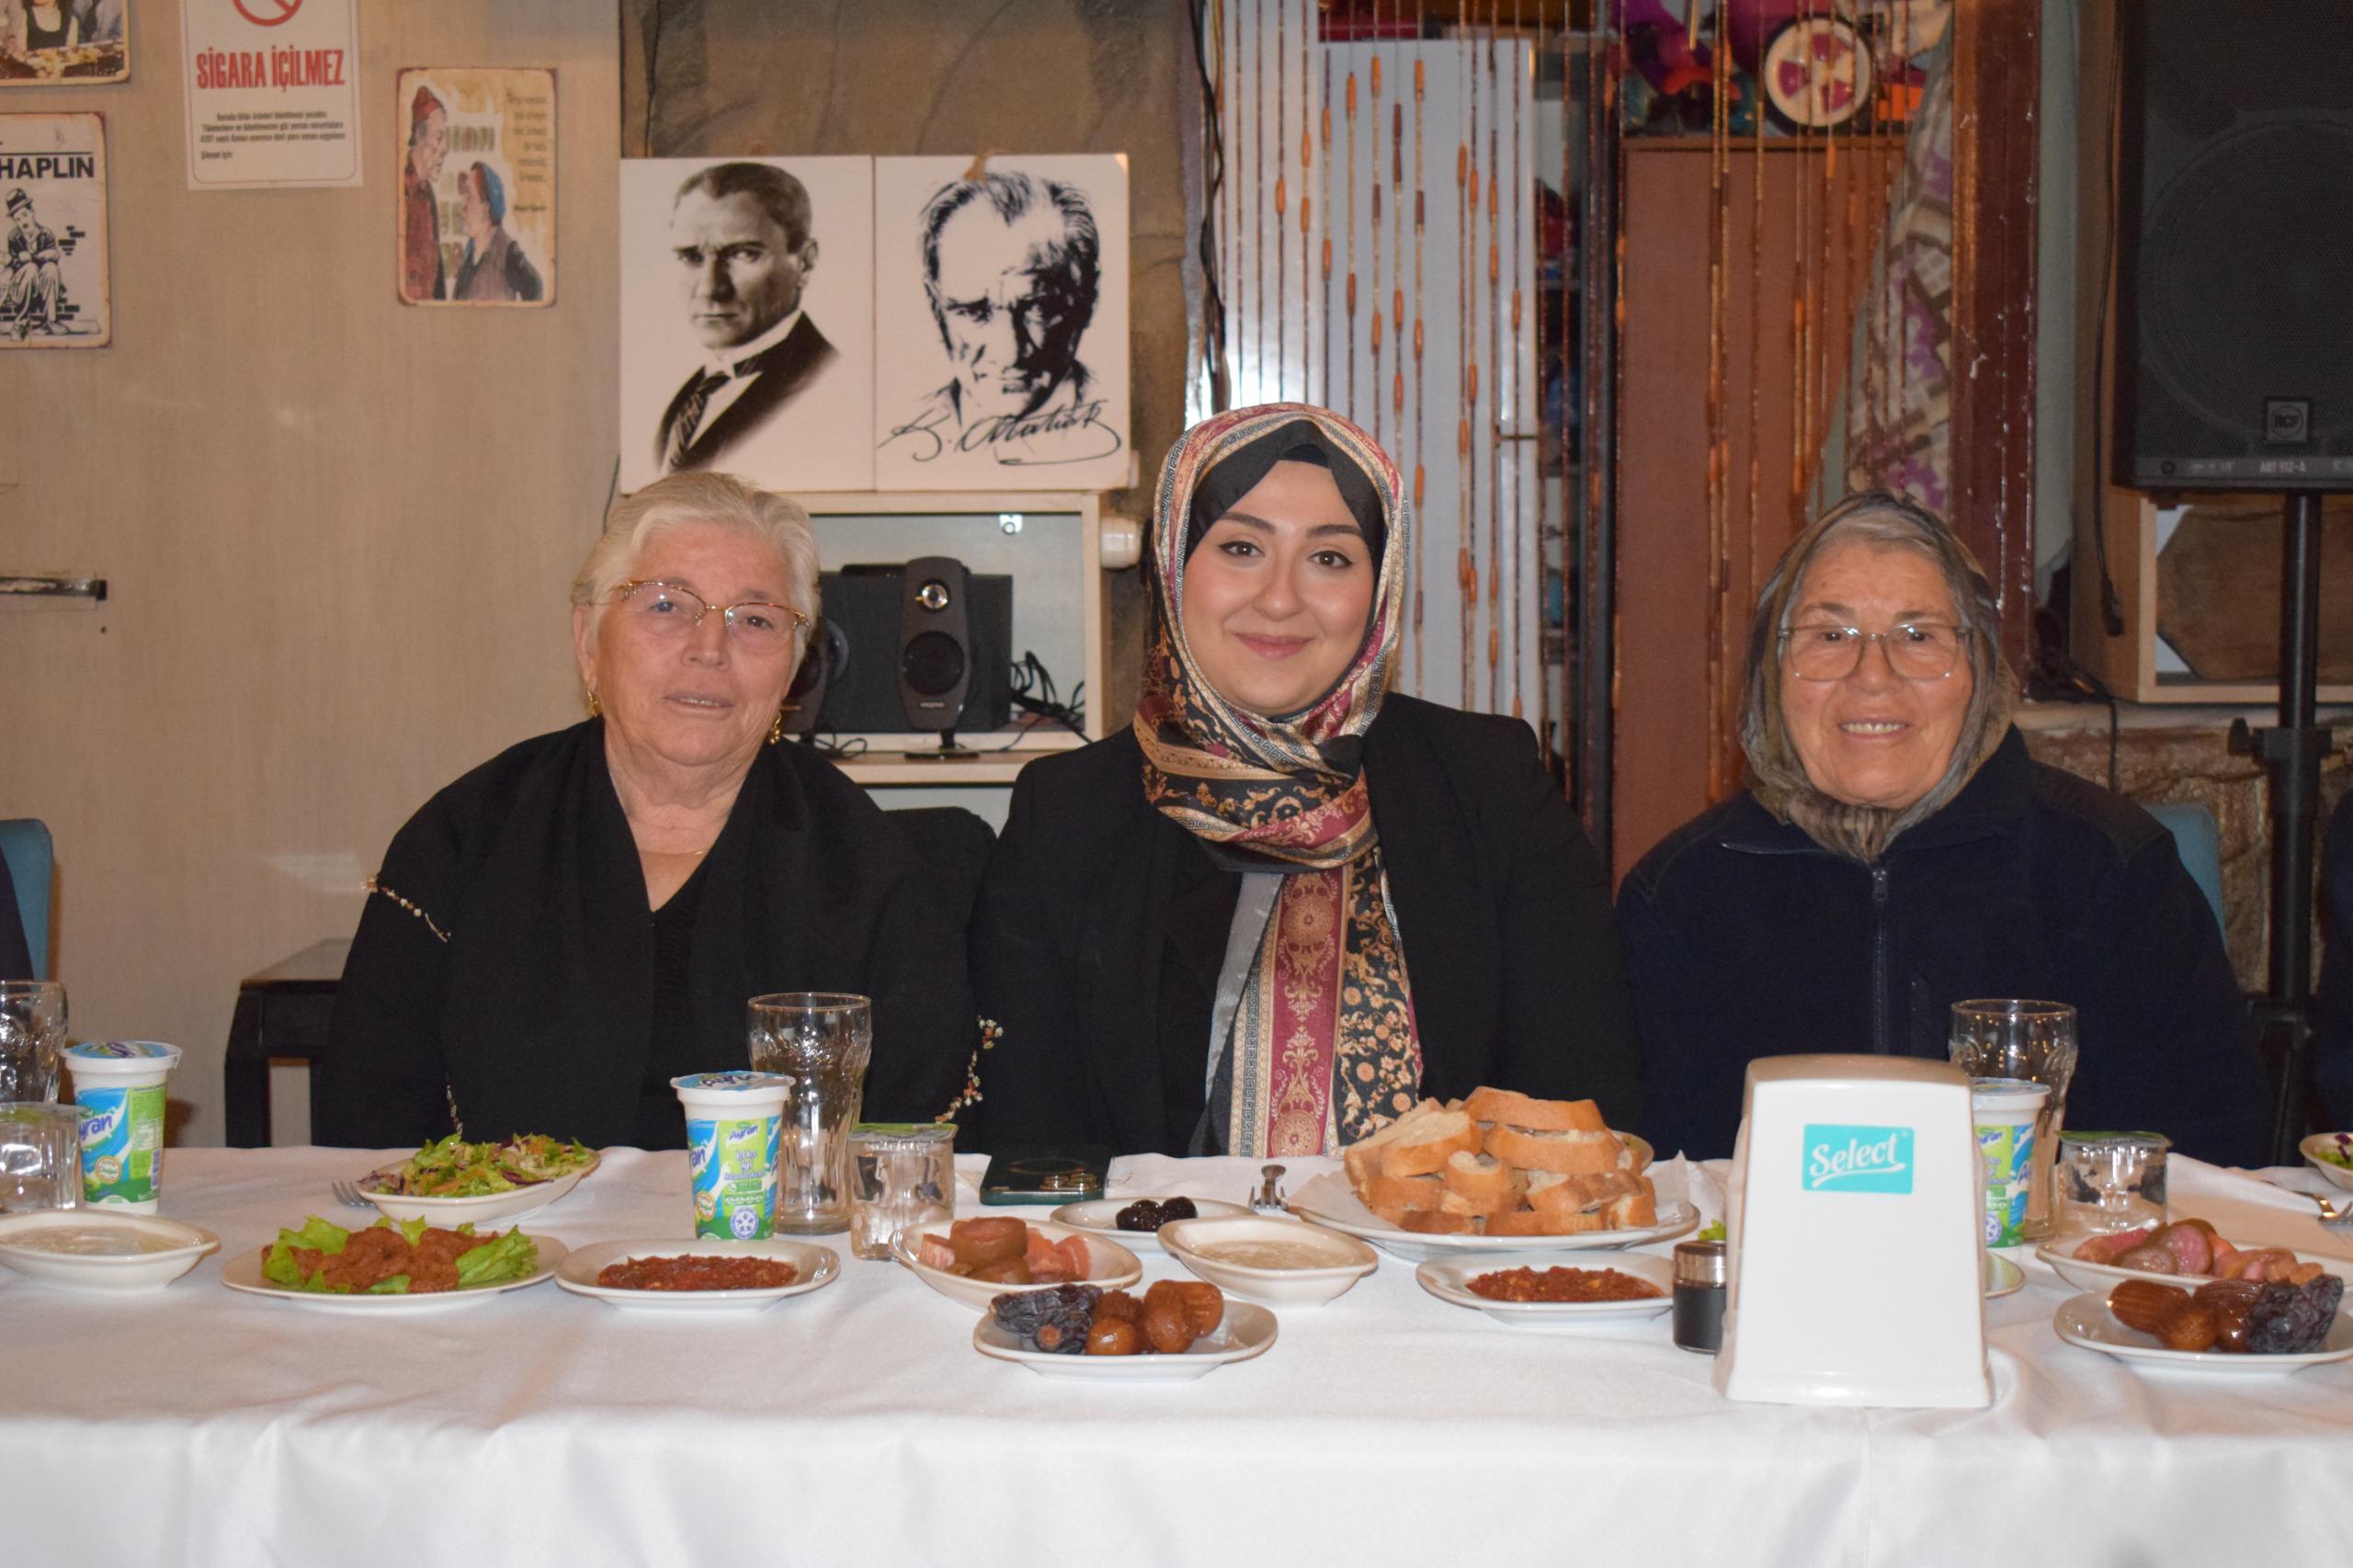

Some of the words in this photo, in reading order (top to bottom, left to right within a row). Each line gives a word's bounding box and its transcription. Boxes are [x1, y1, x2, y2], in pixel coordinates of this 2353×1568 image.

[197, 46, 267, 89] SİGARA
[272, 45, 346, 93] İÇİLMEZ
[79, 1114, 113, 1140] yran
[1809, 1131, 1898, 1177] Select
